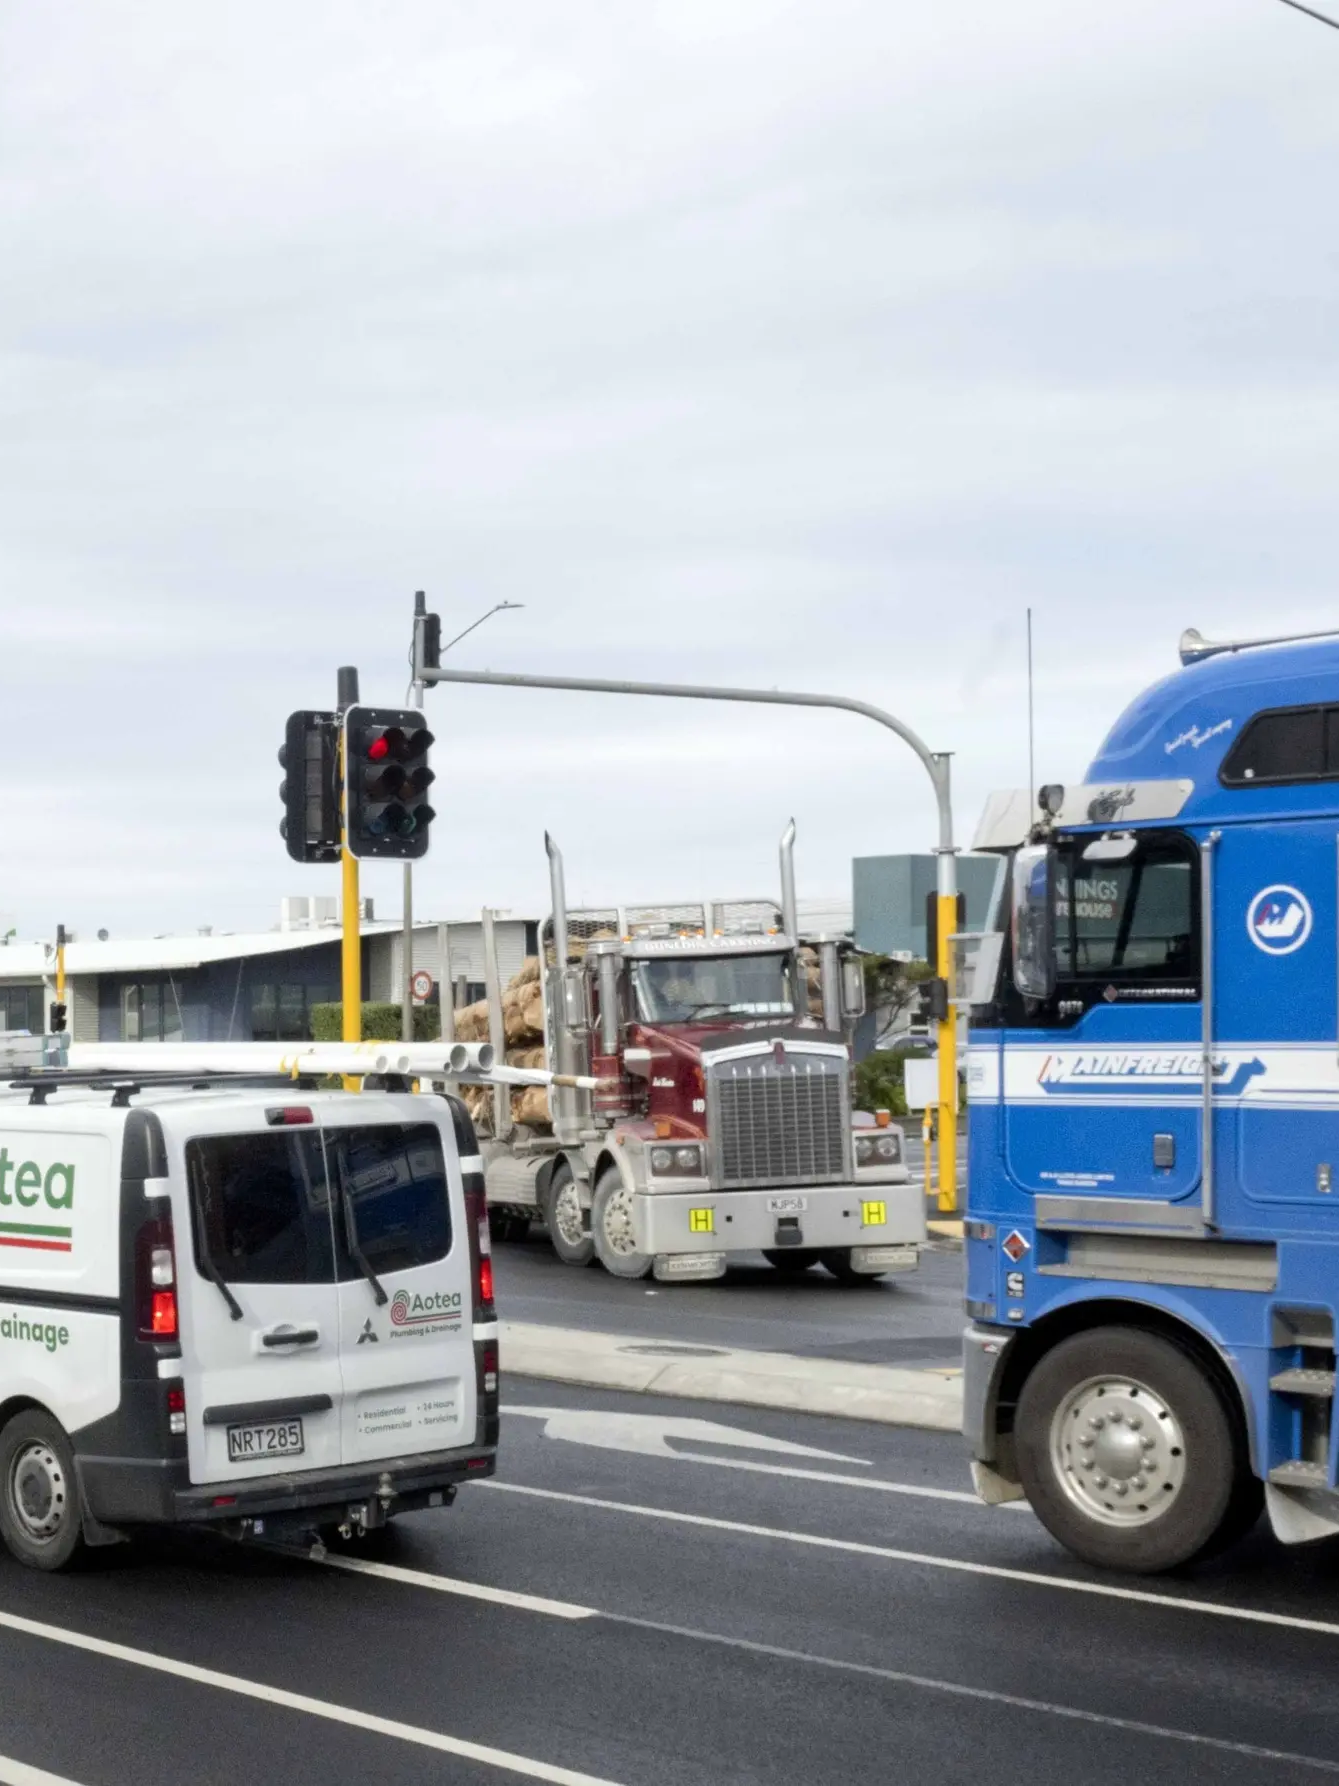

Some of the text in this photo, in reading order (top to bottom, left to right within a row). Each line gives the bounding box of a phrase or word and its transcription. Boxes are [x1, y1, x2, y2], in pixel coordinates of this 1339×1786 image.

[417, 980, 427, 991] 50
[695, 1211, 709, 1230] H
[868, 1203, 881, 1224] H
[412, 1292, 462, 1312] Aotea
[390, 1328, 424, 1339] Plumbing
[431, 1323, 462, 1333] Drainage
[363, 1406, 406, 1420] Residential
[433, 1400, 455, 1410] Hours
[364, 1414, 458, 1434] Commercial Servicing
[231, 1425, 299, 1453] NRT285
